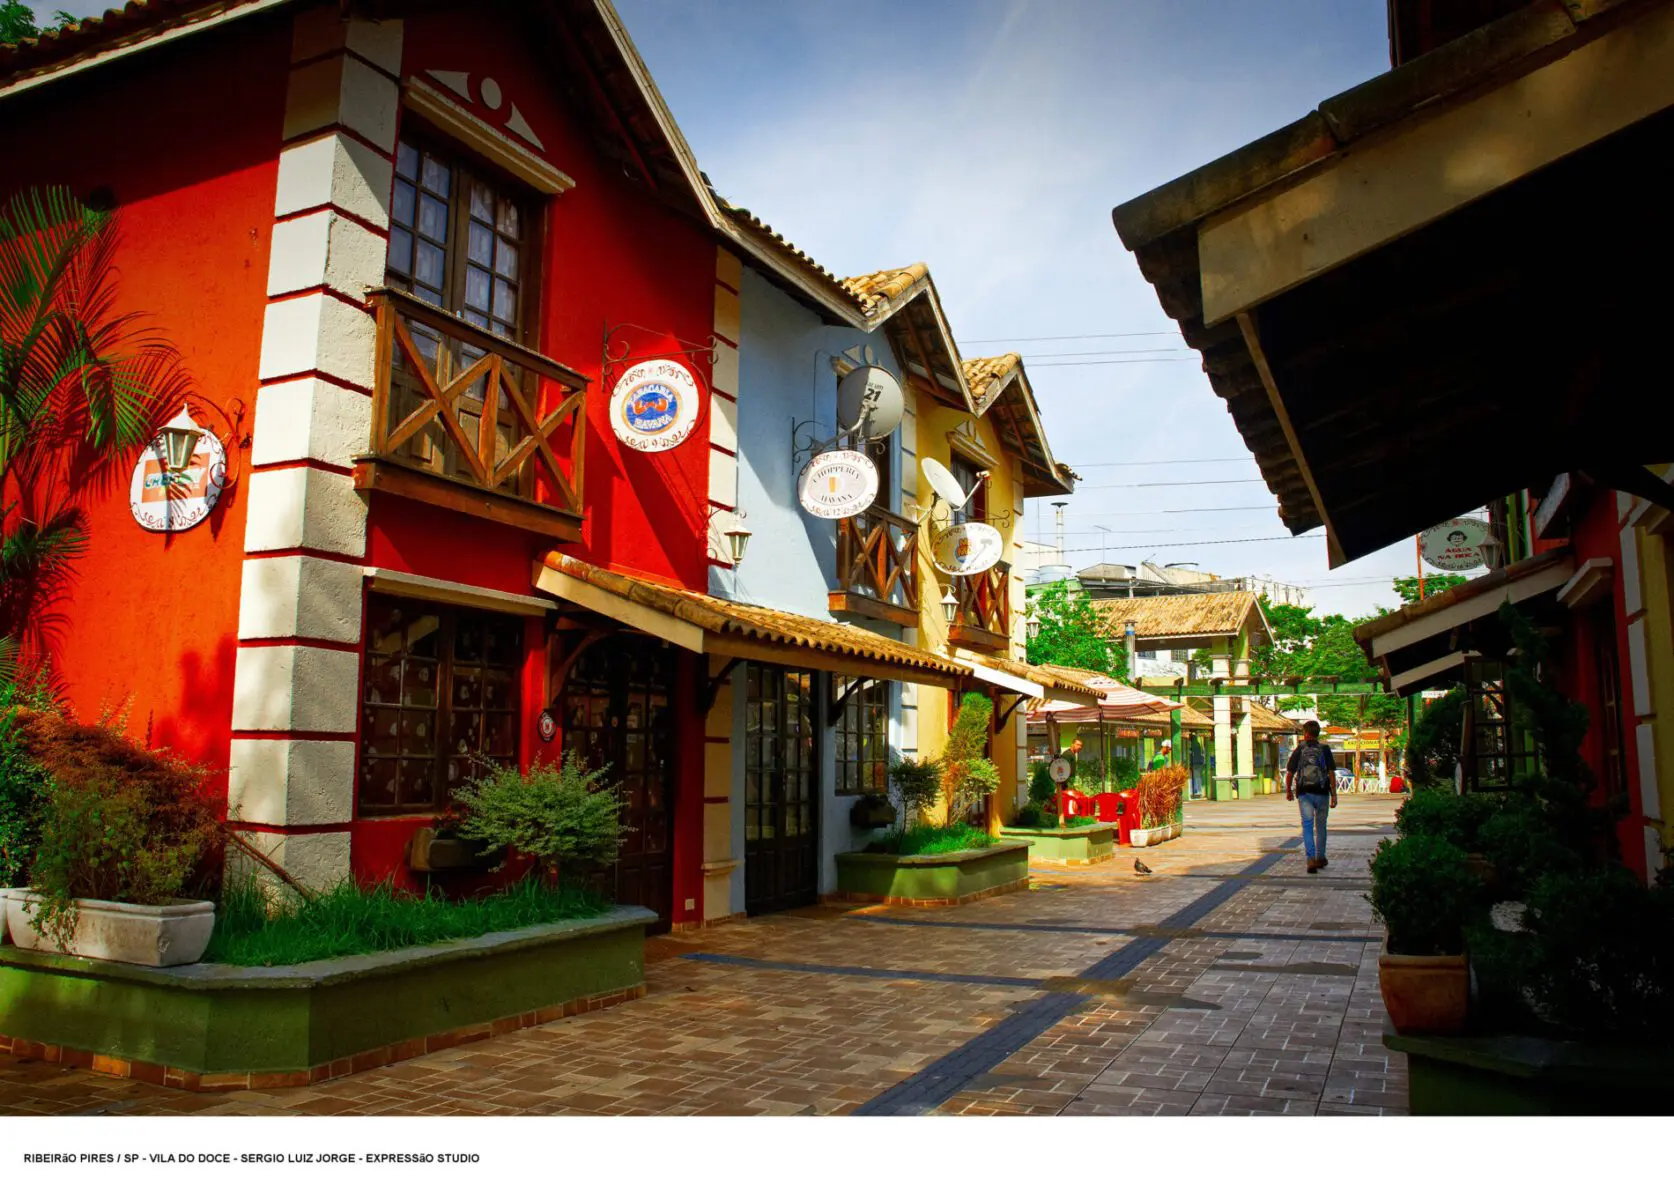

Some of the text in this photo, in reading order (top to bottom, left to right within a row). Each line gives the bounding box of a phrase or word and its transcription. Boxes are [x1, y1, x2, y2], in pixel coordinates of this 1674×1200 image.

[863, 388, 881, 402] 21
[633, 413, 673, 431] HAVANA
[812, 466, 860, 484] CHOPPERIA
[821, 493, 853, 504] HAVANA
